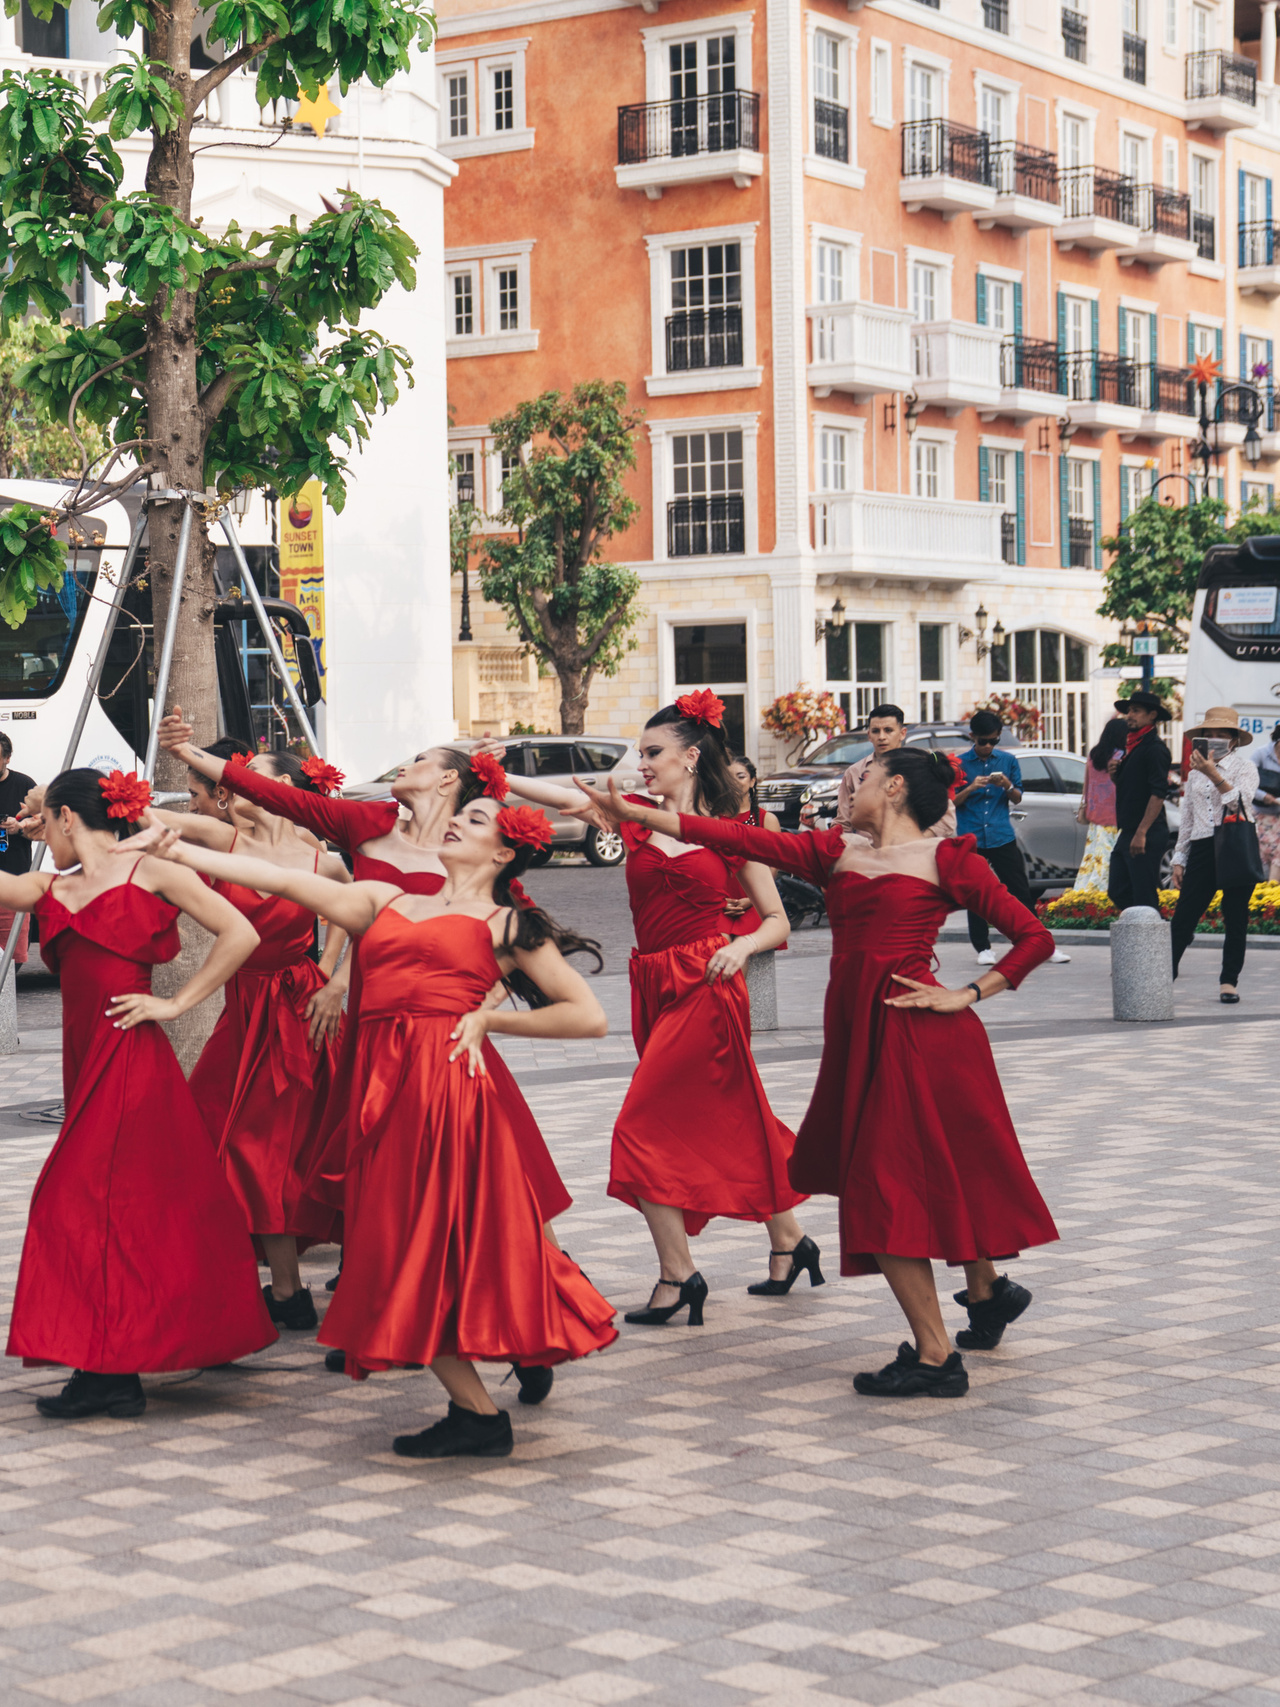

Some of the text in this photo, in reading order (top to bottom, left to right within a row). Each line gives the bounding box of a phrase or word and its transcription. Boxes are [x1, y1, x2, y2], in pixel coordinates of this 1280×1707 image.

[284, 530, 317, 542] SUNSET
[289, 542, 314, 553] TOWN
[299, 593, 319, 605] Arts
[13, 711, 36, 720] NOBLE
[1240, 717, 1280, 734] 8B-
